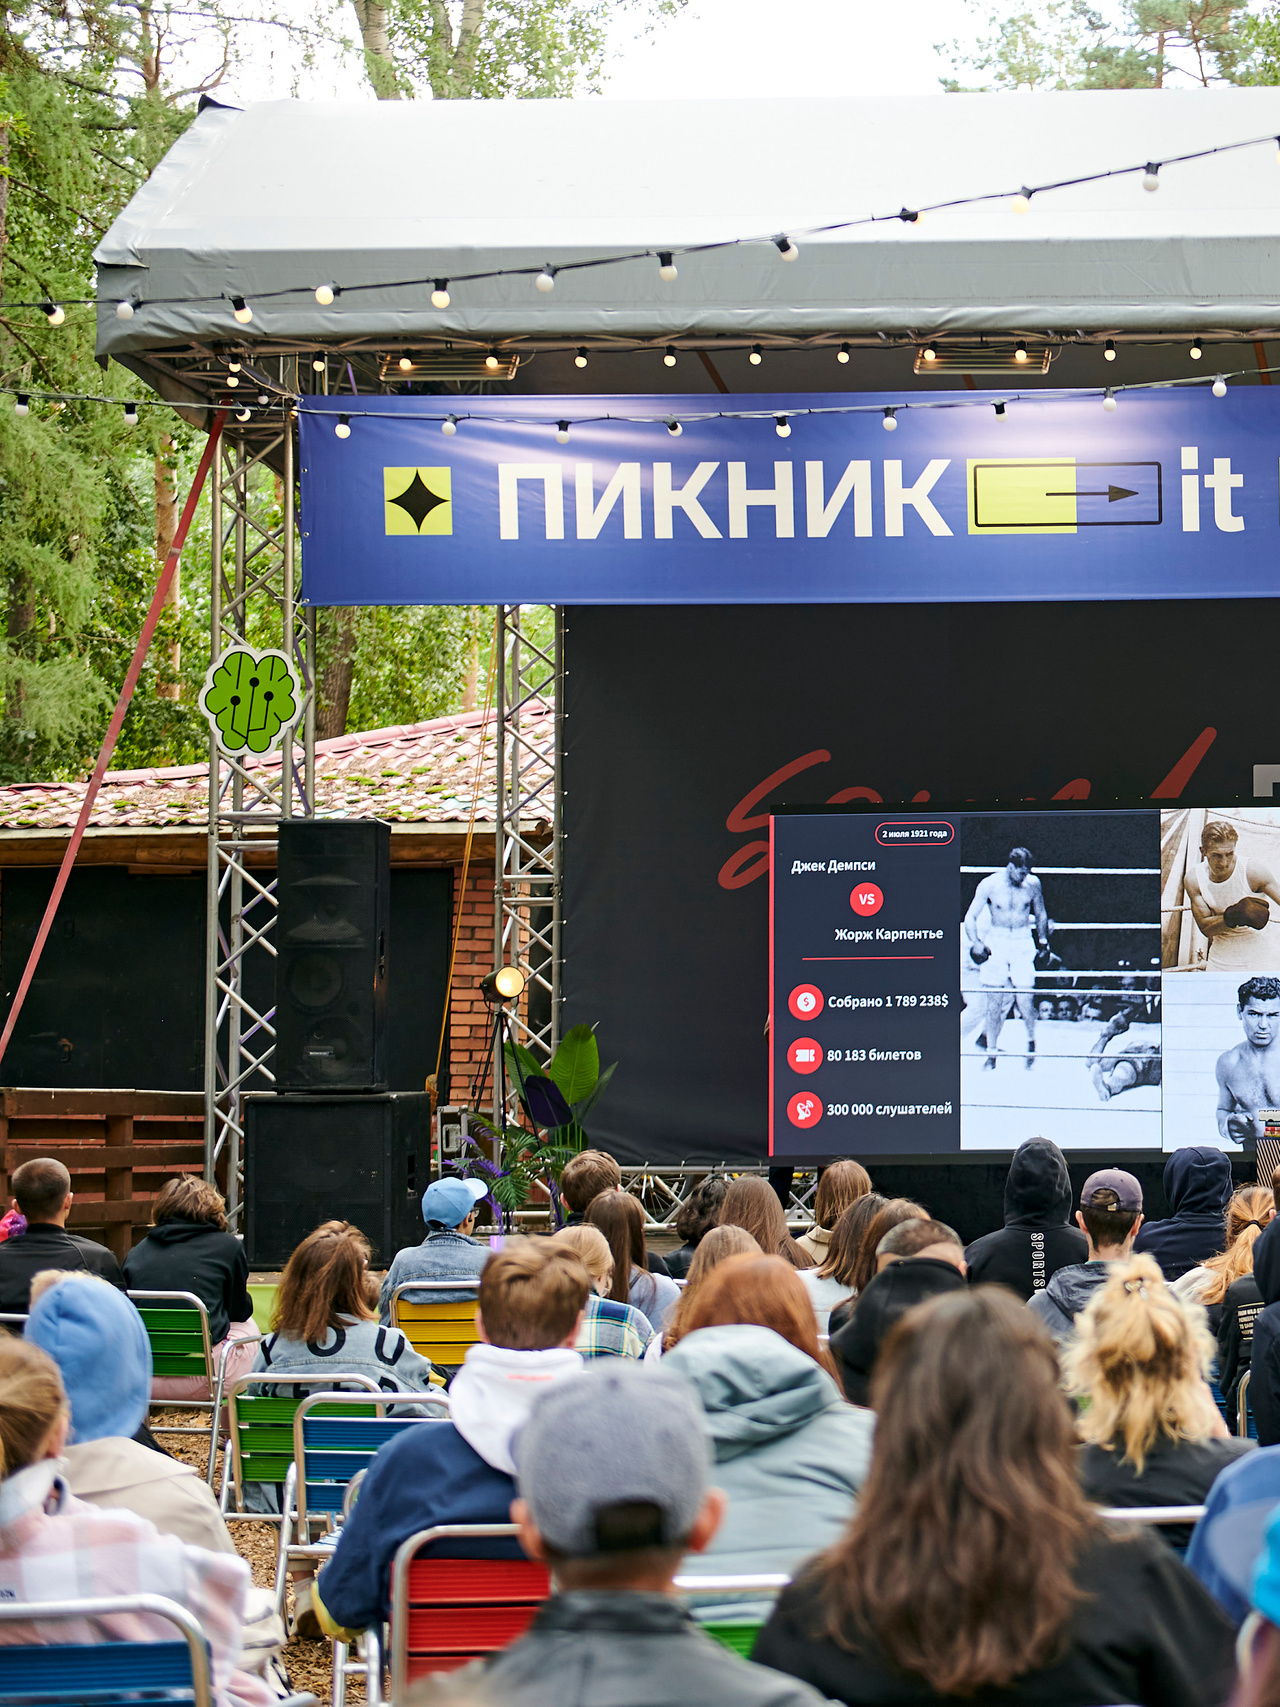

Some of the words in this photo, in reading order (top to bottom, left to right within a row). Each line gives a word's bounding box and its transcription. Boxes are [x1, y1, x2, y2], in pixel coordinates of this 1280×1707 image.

[1181, 446, 1245, 533] it
[498, 459, 954, 540] ПИКНИК
[882, 830, 888, 838] 2
[888, 830, 910, 839] июля
[910, 829, 929, 838] 1921
[929, 830, 948, 839] года
[790, 860, 826, 875] Джек
[827, 859, 876, 874] Демпси
[858, 893, 876, 905] VS
[834, 928, 874, 943] Жорж
[875, 928, 944, 943] Карпентье
[828, 995, 883, 1010] Собрано
[885, 996, 893, 1008] 1
[894, 995, 918, 1007] 789
[919, 993, 949, 1008] 238$
[826, 1049, 842, 1062] 80
[844, 1049, 867, 1061] 183
[868, 1048, 922, 1061] билетов
[826, 1103, 849, 1116] 300
[851, 1103, 874, 1115] 000
[875, 1101, 952, 1118] слушателей
